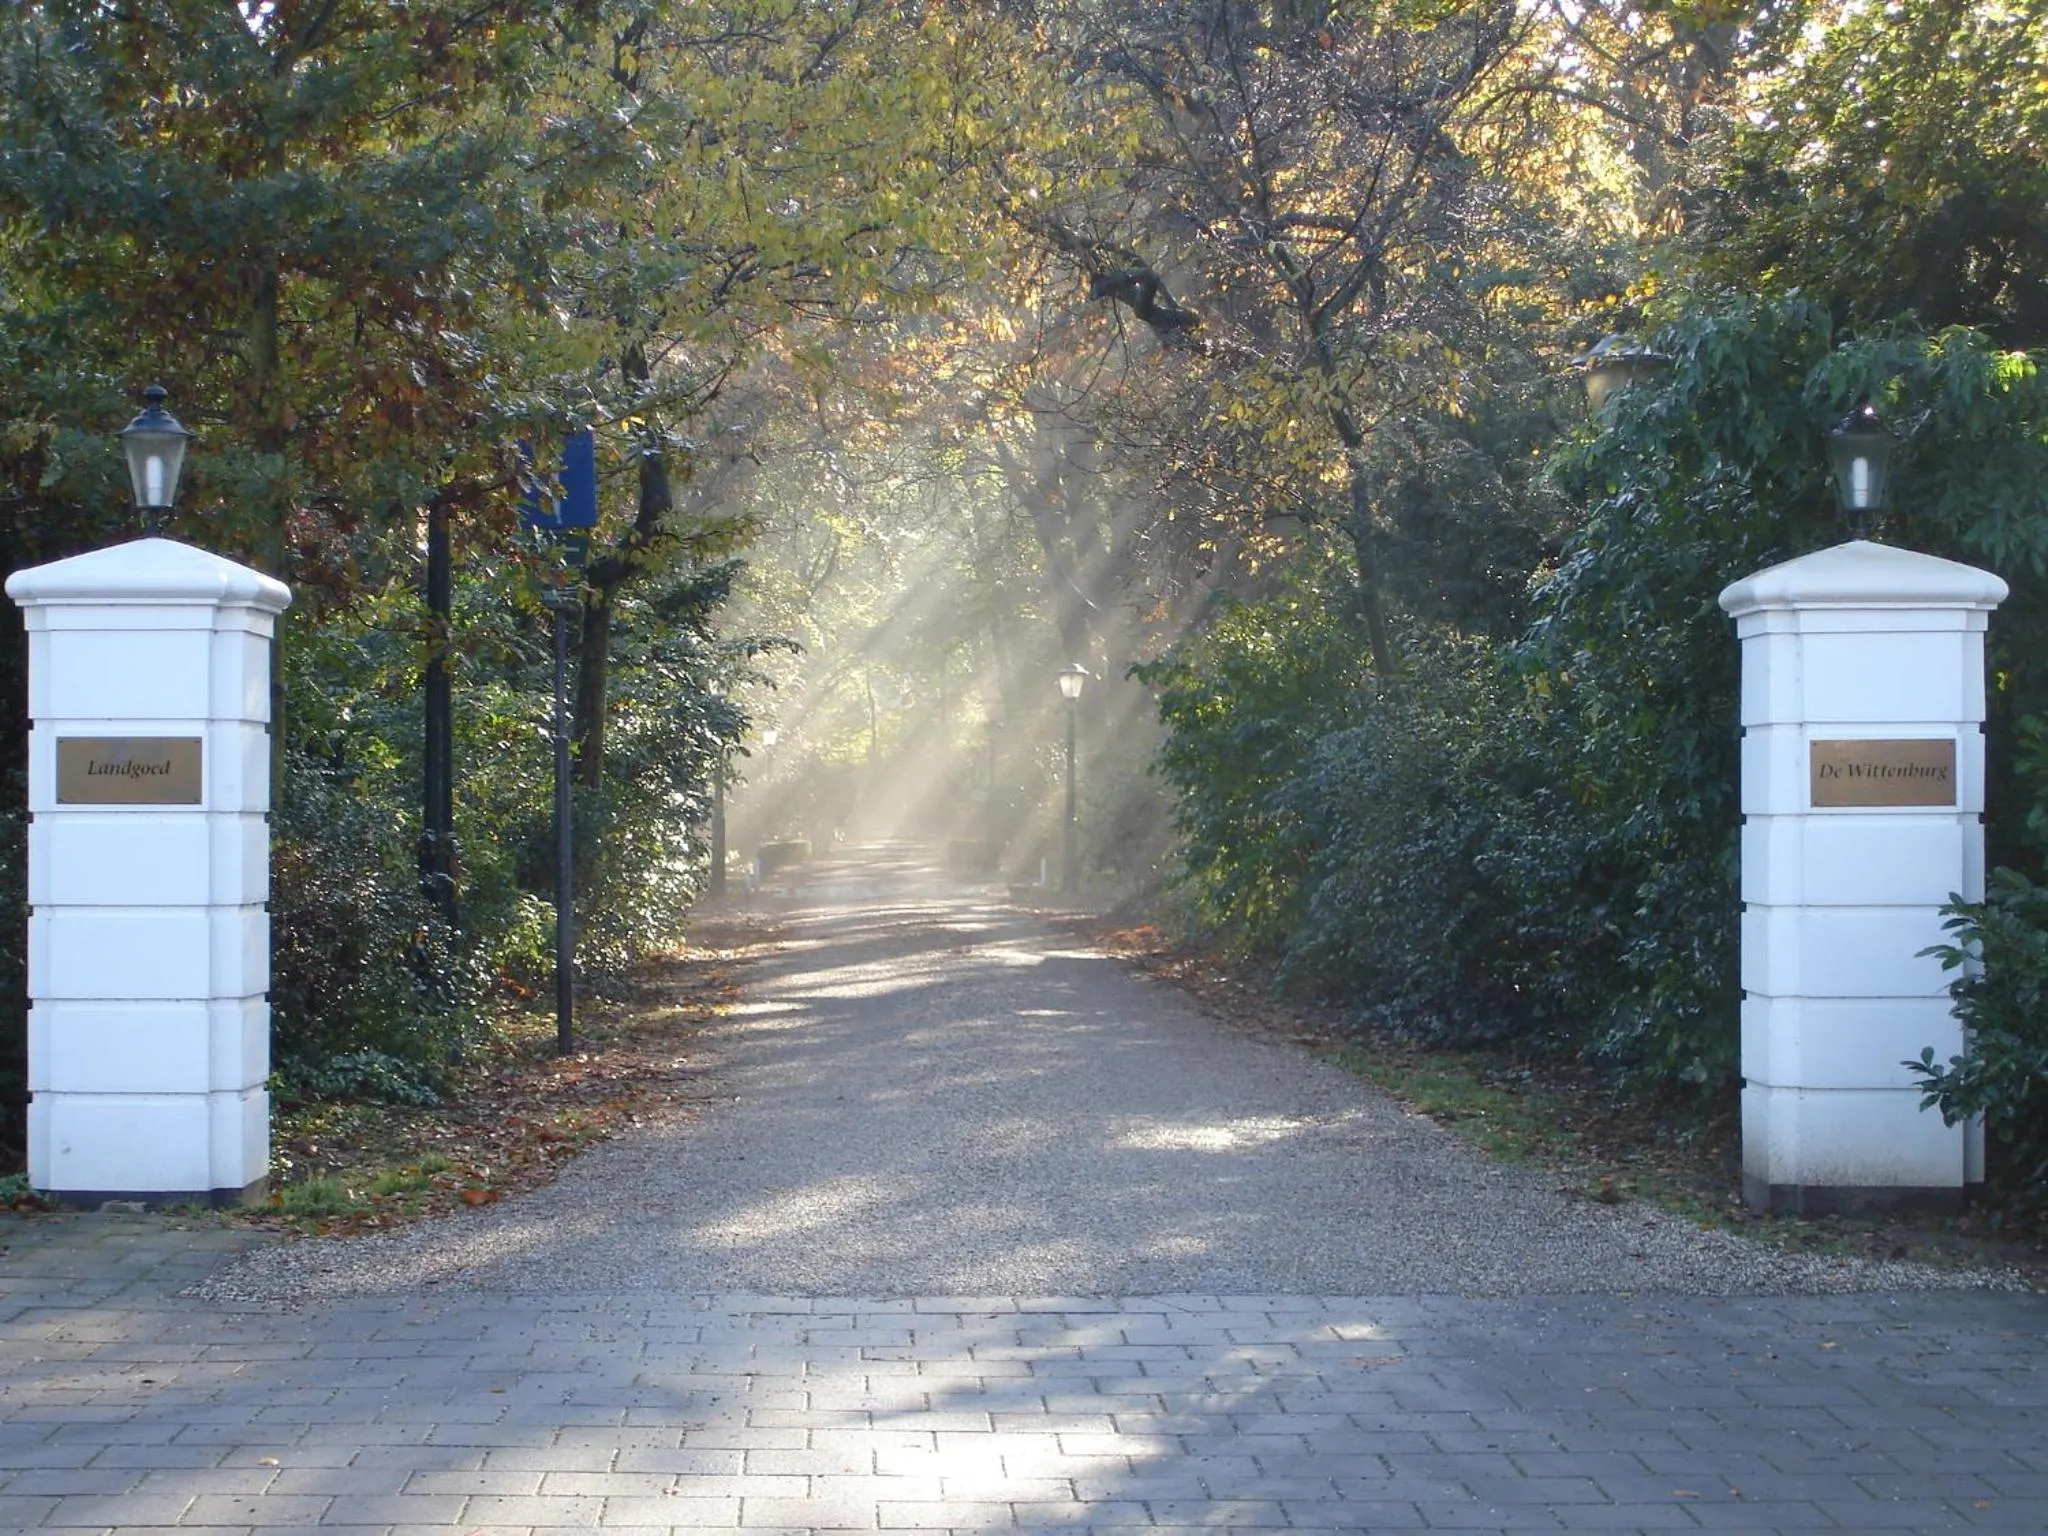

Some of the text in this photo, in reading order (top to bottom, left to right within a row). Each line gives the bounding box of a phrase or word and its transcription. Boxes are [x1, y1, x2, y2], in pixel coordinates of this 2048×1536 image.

[88, 760, 170, 780] Landgoed
[1819, 762, 1948, 783] De Wittenburg
